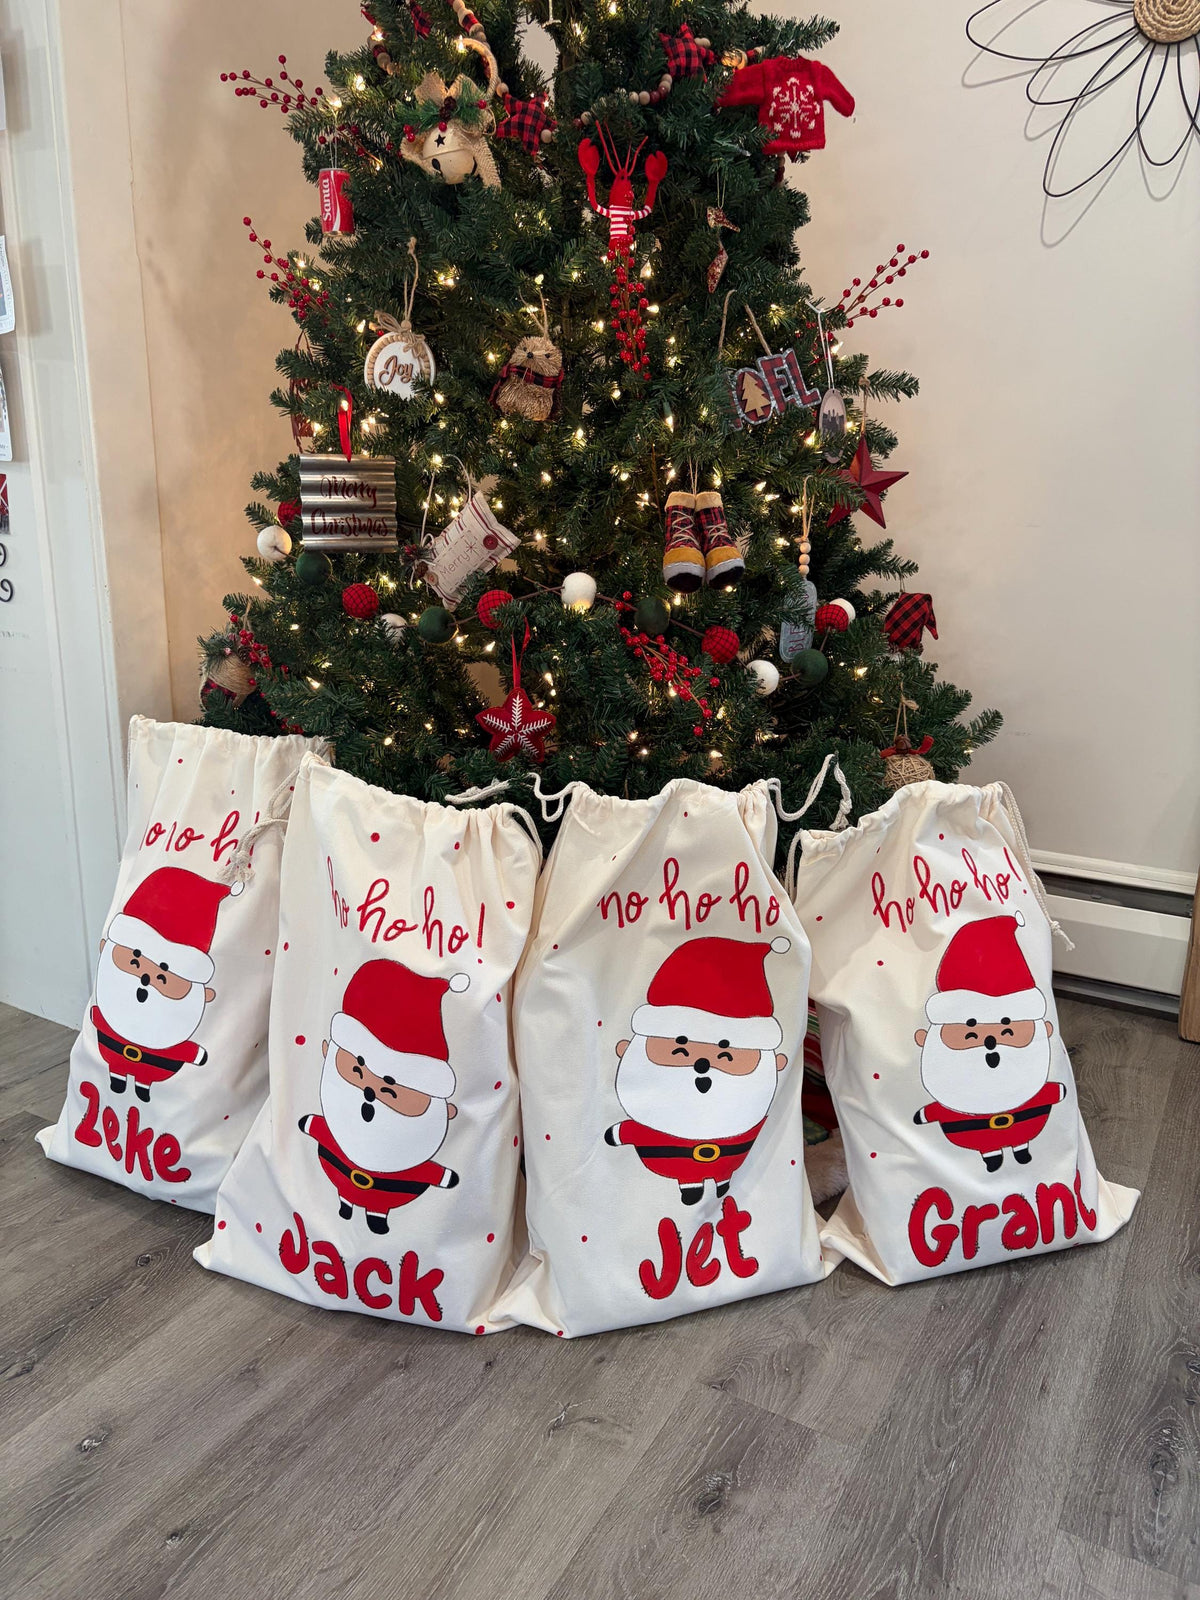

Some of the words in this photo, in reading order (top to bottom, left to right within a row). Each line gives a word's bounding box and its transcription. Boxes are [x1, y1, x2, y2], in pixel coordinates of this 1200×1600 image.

[322, 178, 333, 222] Santa
[378, 354, 414, 386] Joy
[310, 507, 390, 537] Christmas
[320, 475, 378, 509] Merry
[440, 550, 470, 579] Merry
[327, 855, 350, 929] ho
[356, 878, 419, 944] ho
[422, 885, 486, 964] ho!
[658, 857, 722, 931] ho
[871, 871, 915, 933] ho
[913, 855, 968, 917] ho
[961, 846, 1027, 905] ho!
[74, 1080, 192, 1183] Zeke
[279, 1212, 445, 1323] Jack
[638, 1196, 760, 1300] Jet
